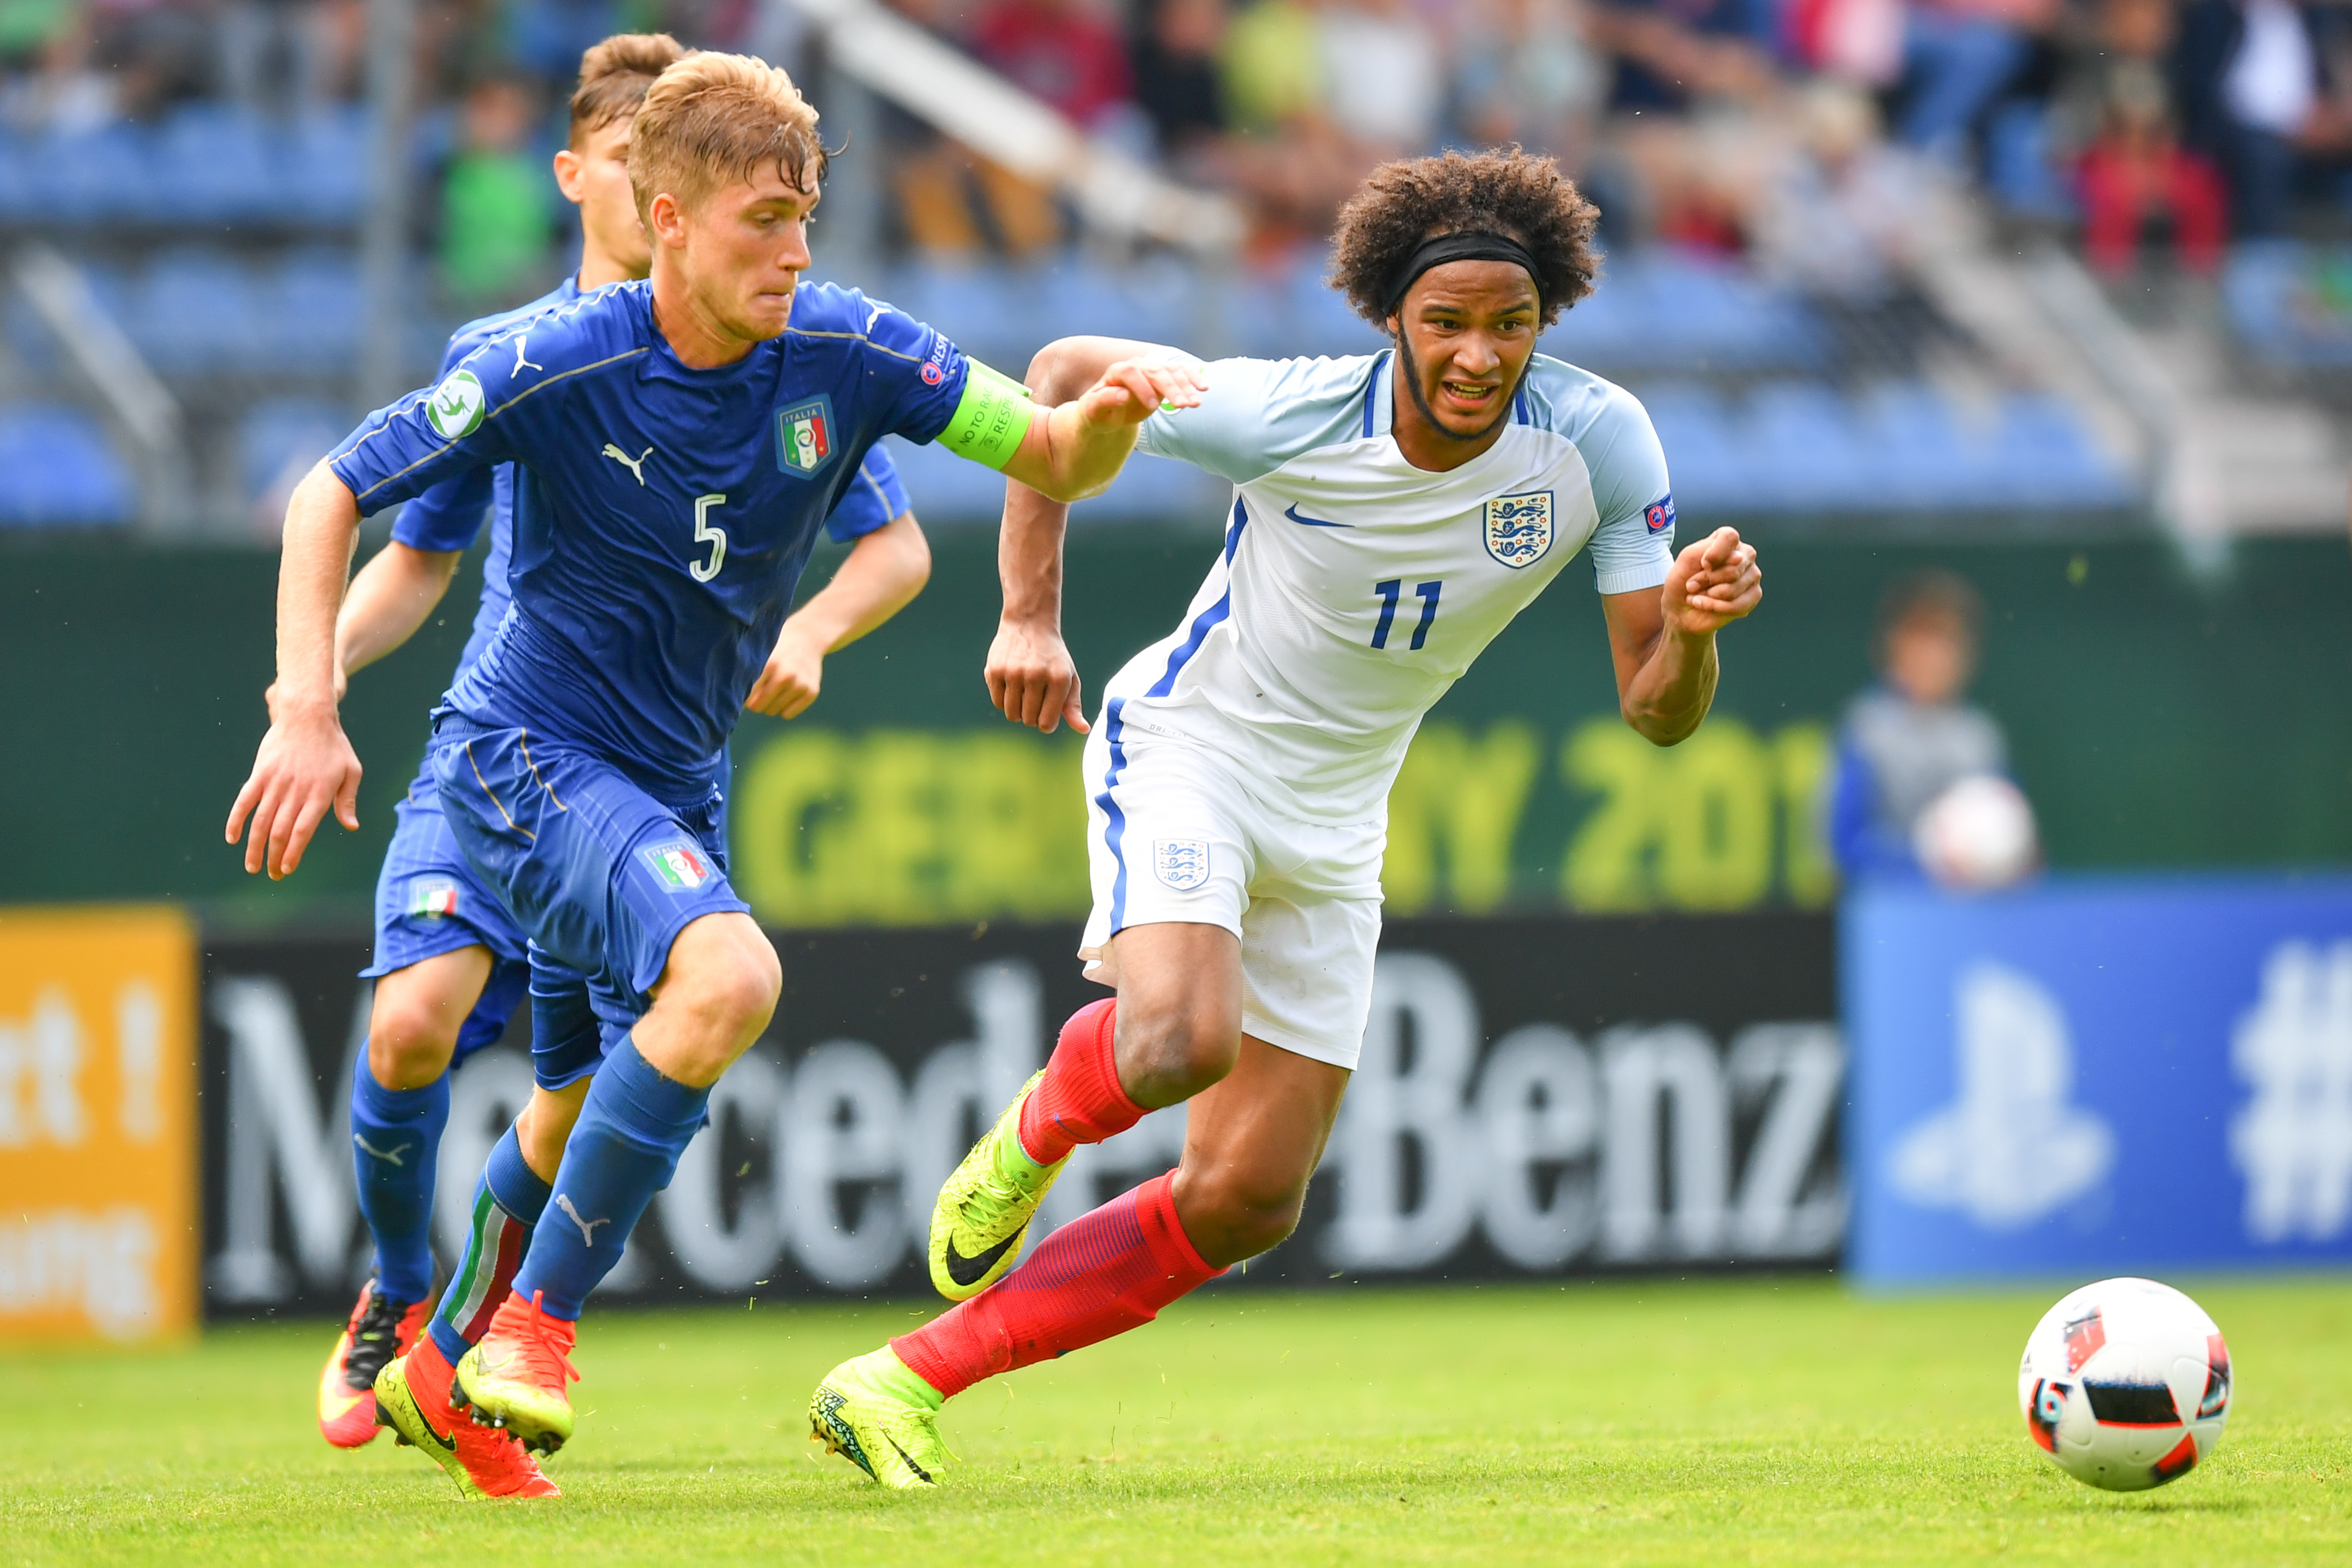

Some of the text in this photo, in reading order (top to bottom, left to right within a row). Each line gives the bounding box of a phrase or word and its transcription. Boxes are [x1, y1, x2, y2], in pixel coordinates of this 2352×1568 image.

[931, 332, 949, 367] RESP
[785, 408, 818, 424] ITALIA
[959, 386, 993, 446] NO TO RAC
[993, 391, 1014, 434] RESPEC
[688, 493, 727, 583] 5
[1370, 578, 1442, 650] 11
